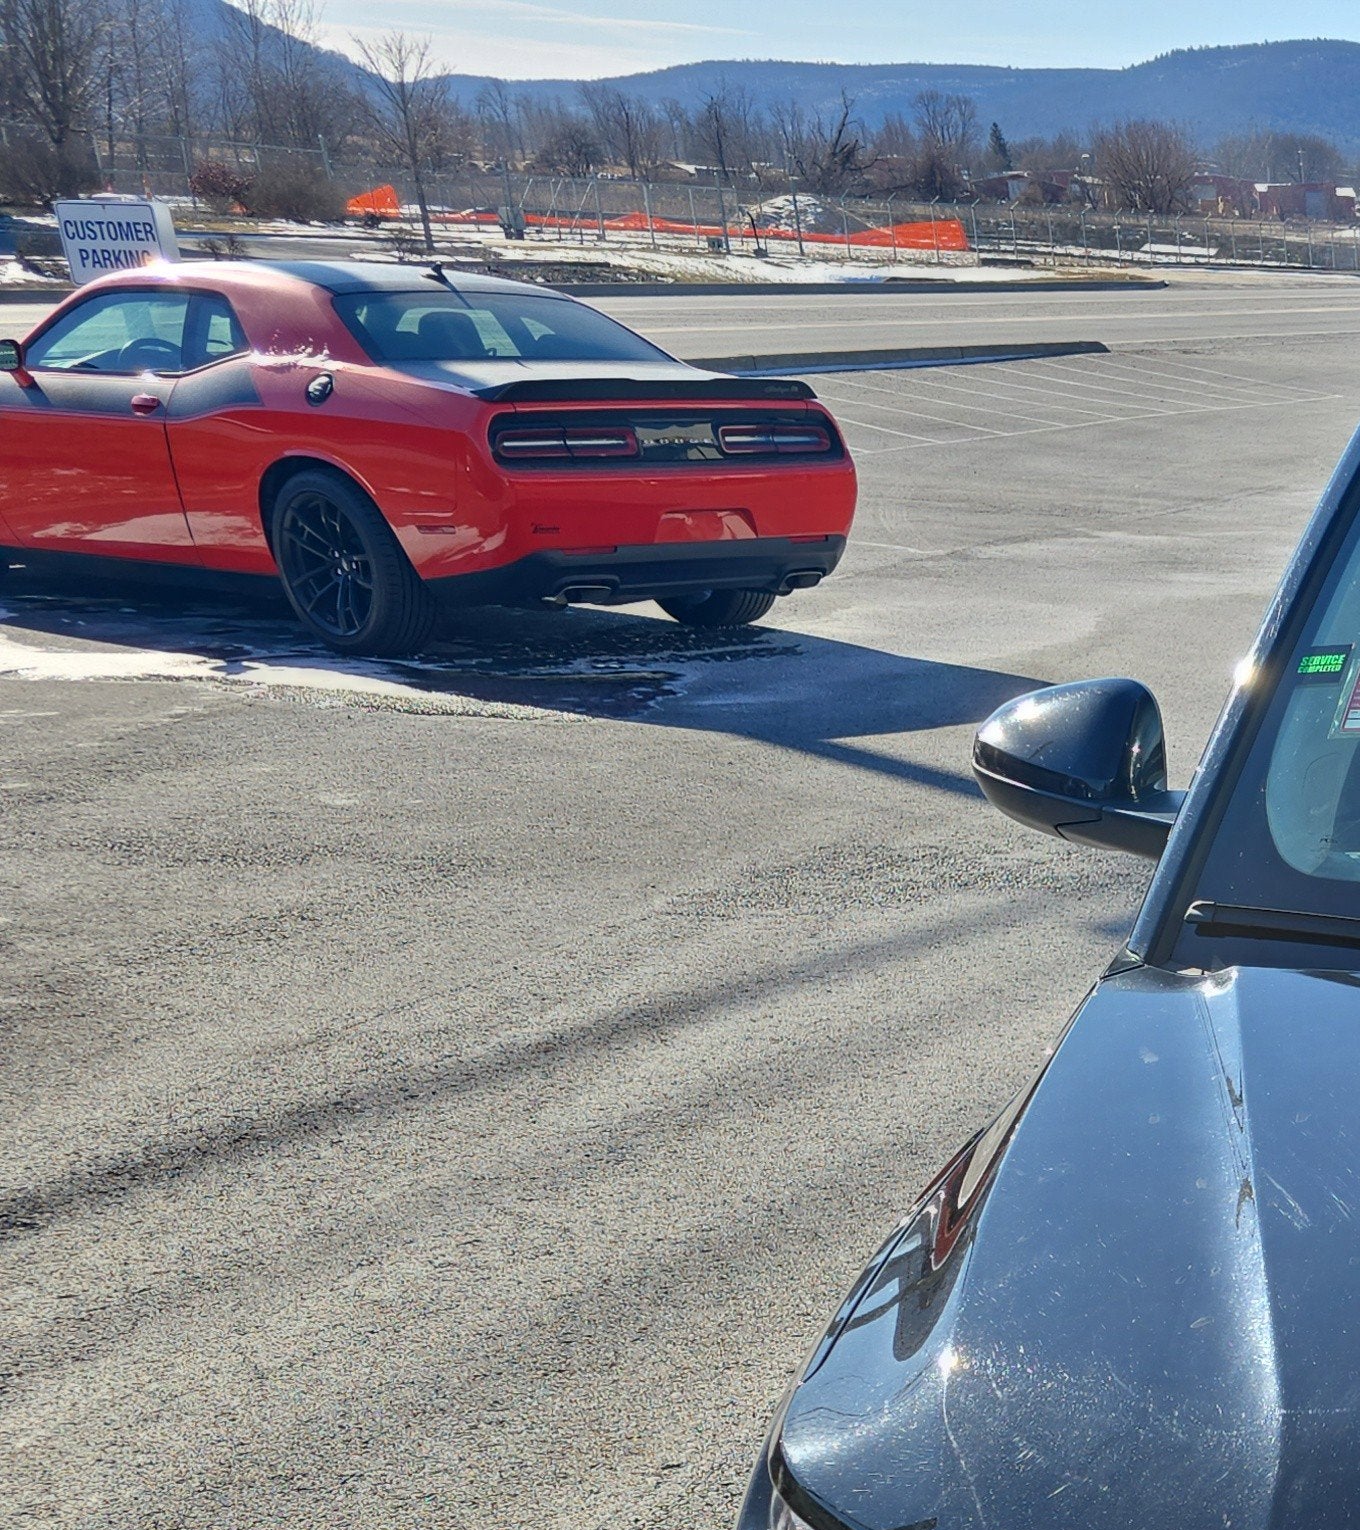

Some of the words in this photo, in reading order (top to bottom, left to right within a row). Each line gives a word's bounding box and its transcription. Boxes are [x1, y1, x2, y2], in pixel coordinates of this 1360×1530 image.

[63, 219, 157, 242] CUSTOMER
[1300, 654, 1346, 666] SERVICE
[1297, 664, 1342, 673] COMPLETED
